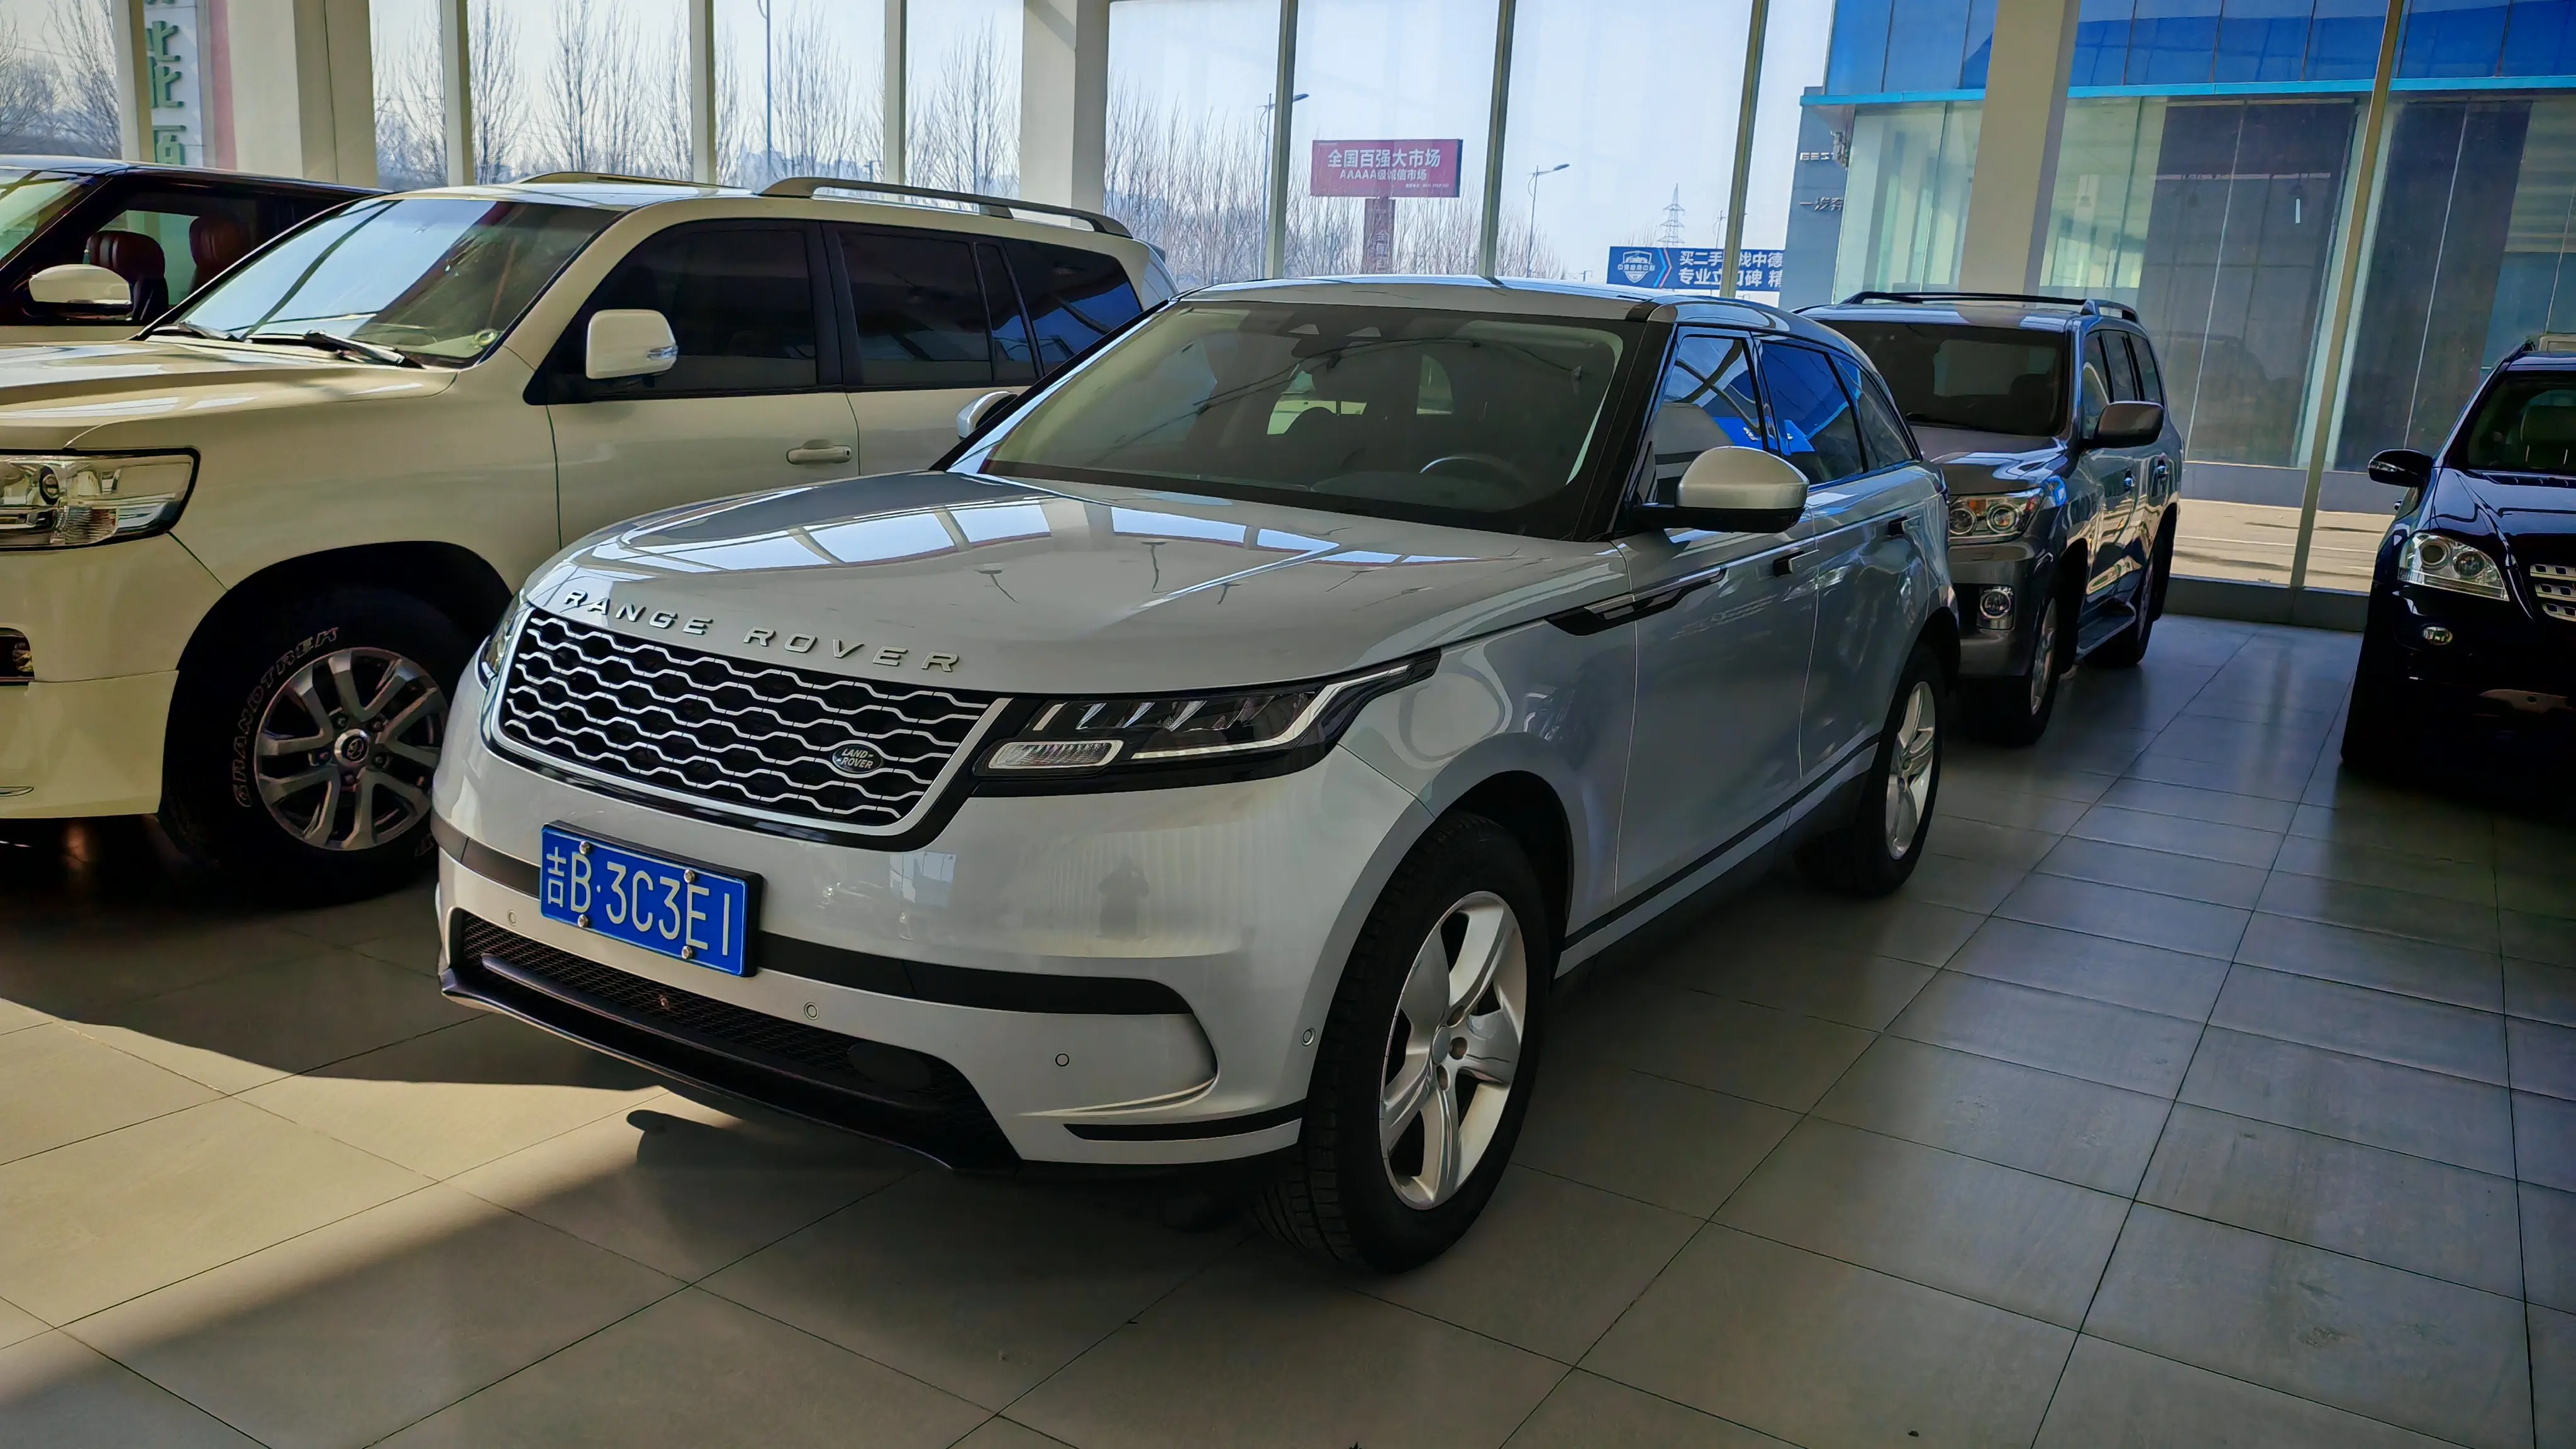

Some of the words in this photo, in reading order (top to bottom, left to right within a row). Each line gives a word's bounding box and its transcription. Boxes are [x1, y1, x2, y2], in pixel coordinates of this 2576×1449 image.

[1327, 148, 1441, 168] 全国百强大市场
[1679, 250, 1784, 269] 买二手找中德
[563, 589, 713, 635] RANGE
[743, 626, 959, 673] ROVER
[841, 748, 869, 758] LAND
[842, 757, 874, 769] ROVER
